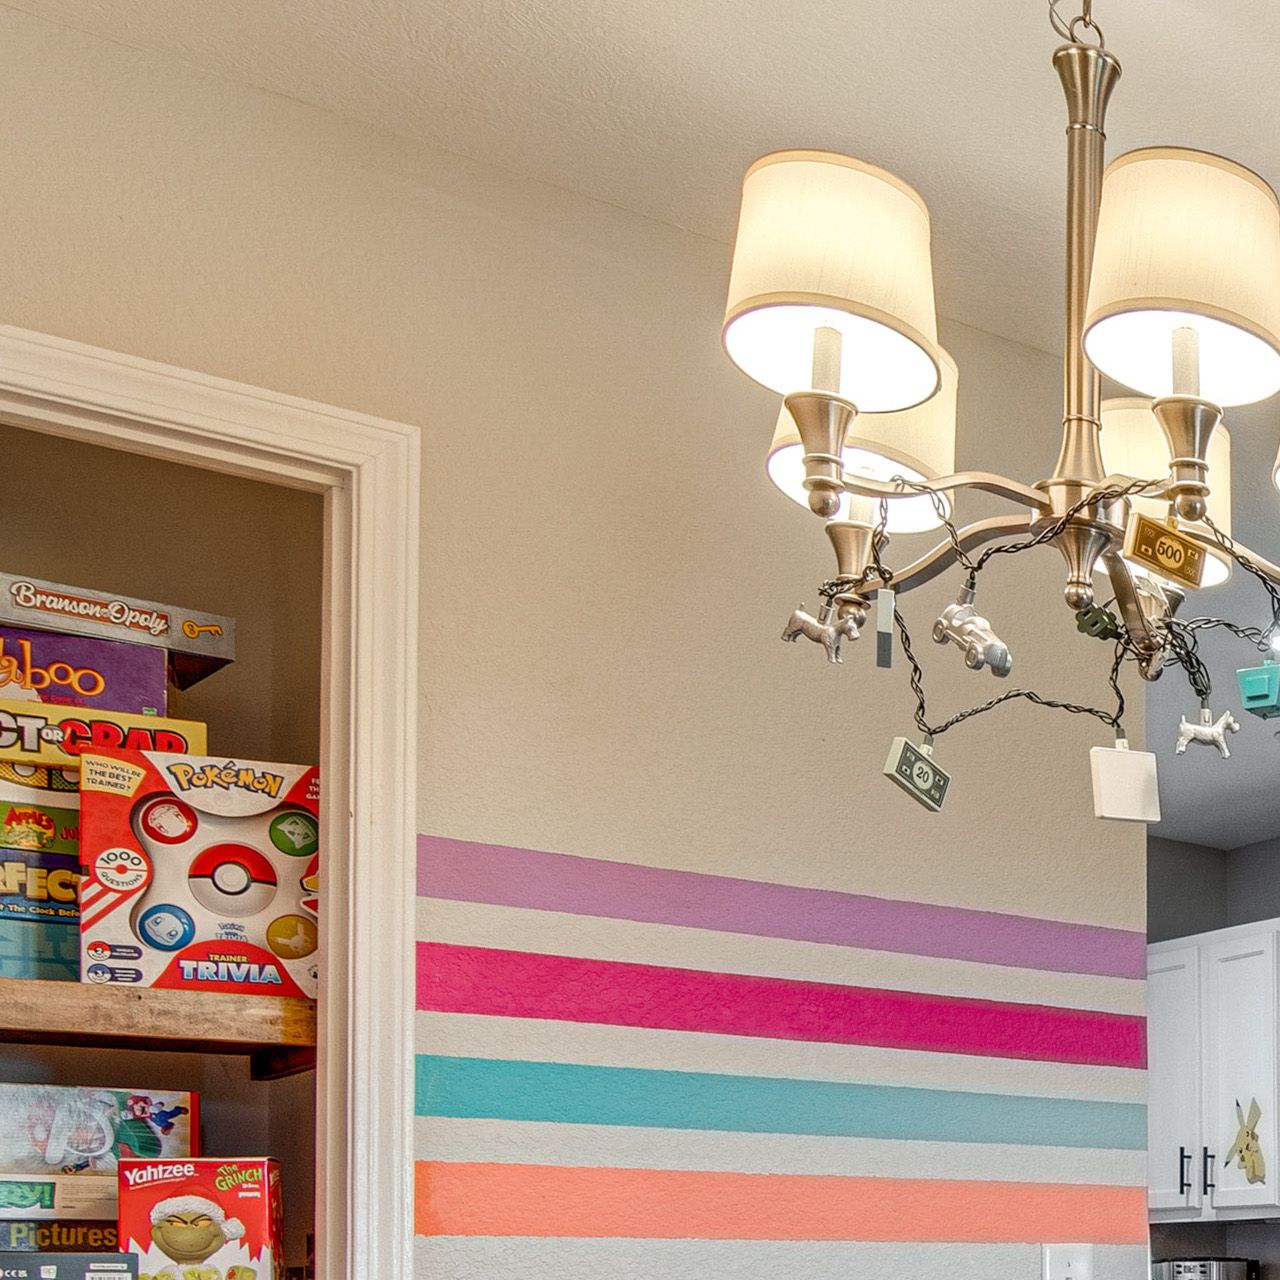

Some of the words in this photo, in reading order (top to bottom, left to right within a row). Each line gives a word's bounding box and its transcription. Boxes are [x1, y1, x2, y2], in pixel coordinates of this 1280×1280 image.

[1157, 541, 1182, 563] 500
[41, 725, 64, 744] OR
[58, 718, 188, 756] CRAP
[86, 760, 108, 769] WHO
[110, 764, 130, 774] WILL
[132, 770, 141, 778] BE
[89, 769, 107, 778] THE
[108, 772, 132, 783] BEST
[916, 766, 929, 783] 20
[86, 778, 131, 792] TRAINER?
[101, 851, 142, 867] 1000
[101, 871, 143, 887] QUESTIONS
[209, 953, 248, 963] TRAINER
[178, 960, 282, 984] TRIVIA
[125, 1163, 195, 1185] Yahtzee
[217, 1165, 238, 1175] The
[215, 1168, 262, 1191] GRINCH
[10, 1223, 117, 1247] Pictures
